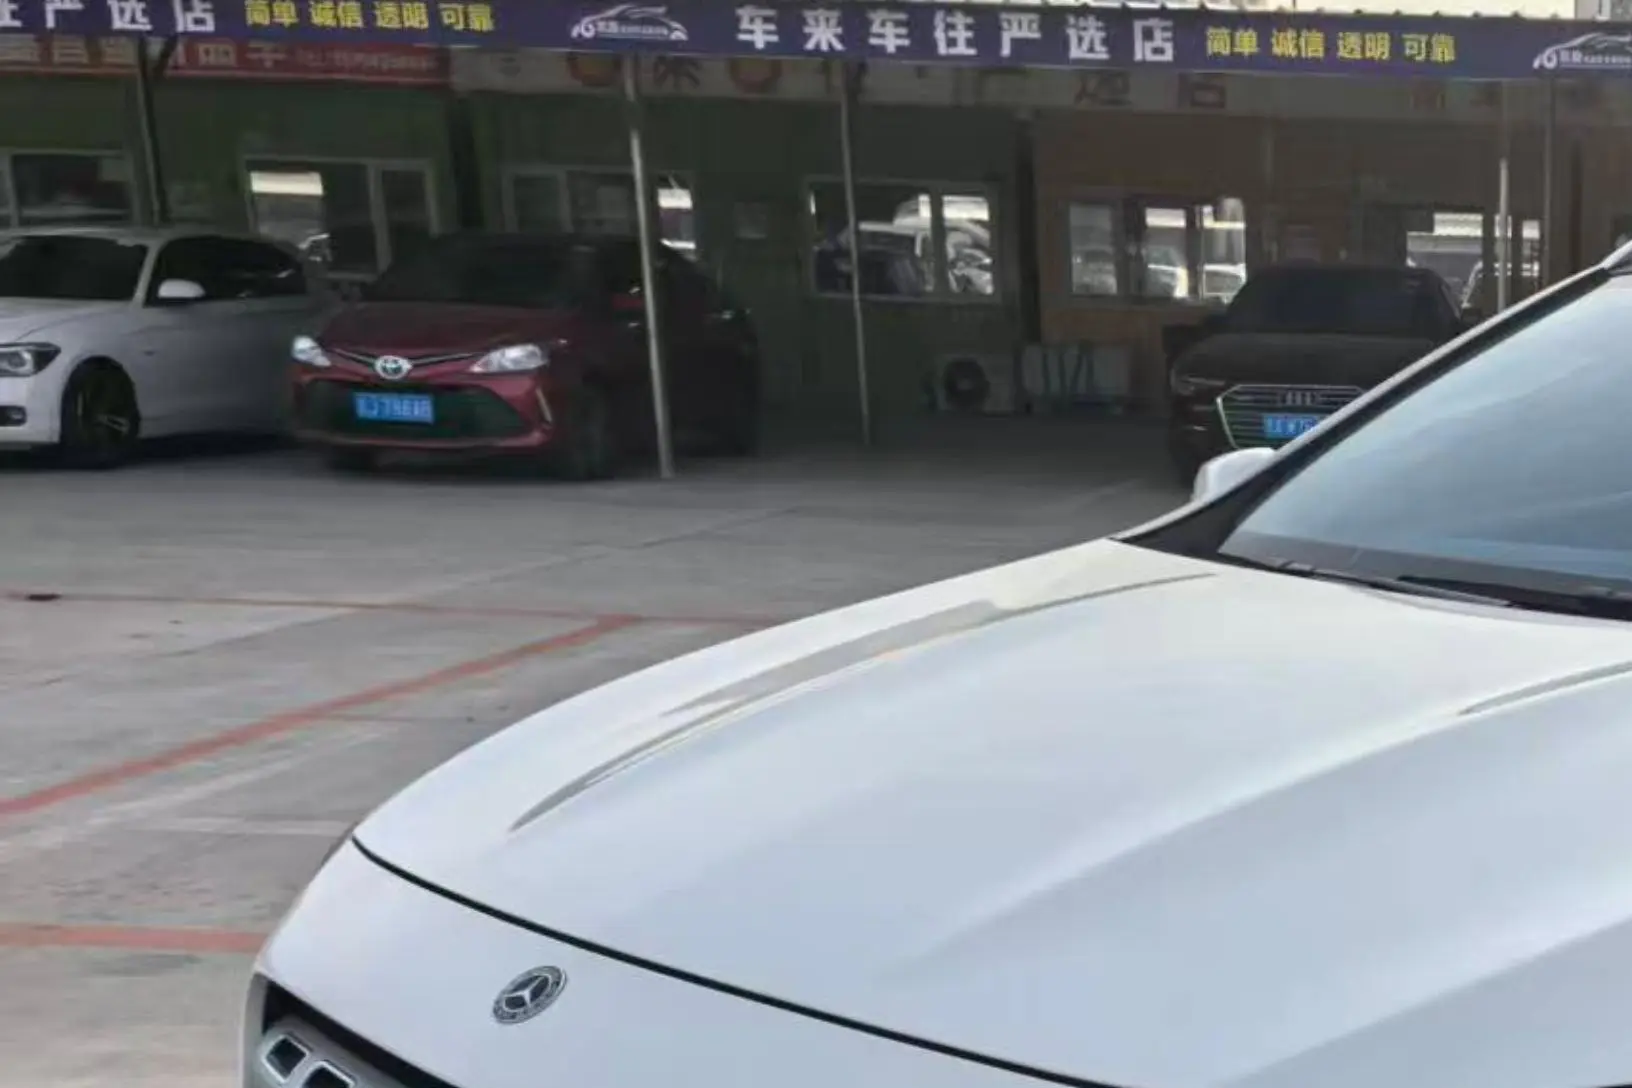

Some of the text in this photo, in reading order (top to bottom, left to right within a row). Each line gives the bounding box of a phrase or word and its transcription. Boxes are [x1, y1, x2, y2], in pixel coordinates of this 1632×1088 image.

[246, 0, 495, 31] 简单 诚信 透明 可靠
[735, 5, 1175, 62] 车来车往严选店
[1206, 26, 1455, 64] 简单 诚信 透明 可靠
